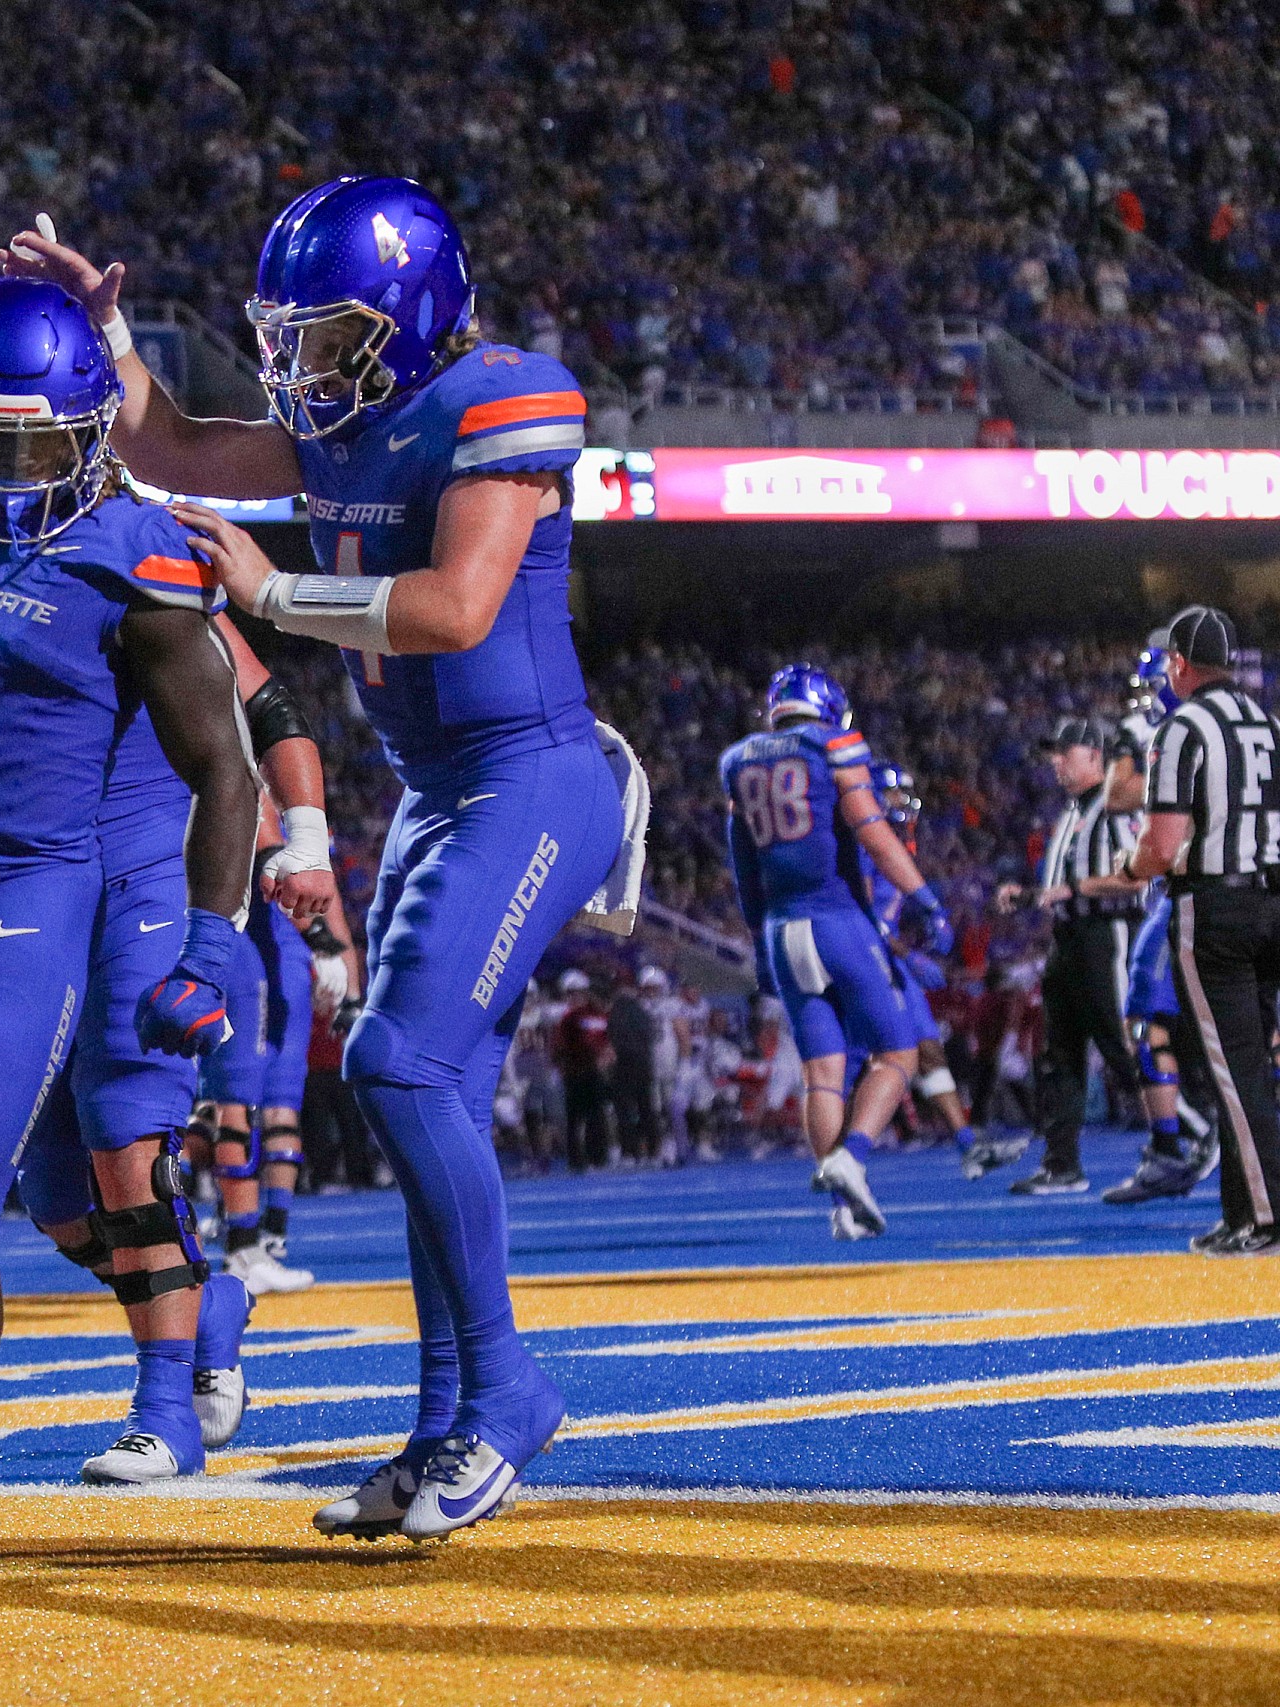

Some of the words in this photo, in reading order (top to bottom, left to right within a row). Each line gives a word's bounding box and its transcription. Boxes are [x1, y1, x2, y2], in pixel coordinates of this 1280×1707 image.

[371, 212, 411, 269] 4
[341, 503, 406, 524] STATE
[1034, 449, 1280, 519] TOUCHD
[738, 757, 814, 848] 88
[1236, 727, 1276, 805] F
[470, 832, 560, 1010] BRONCOS
[10, 983, 77, 1168] BRONCOS
